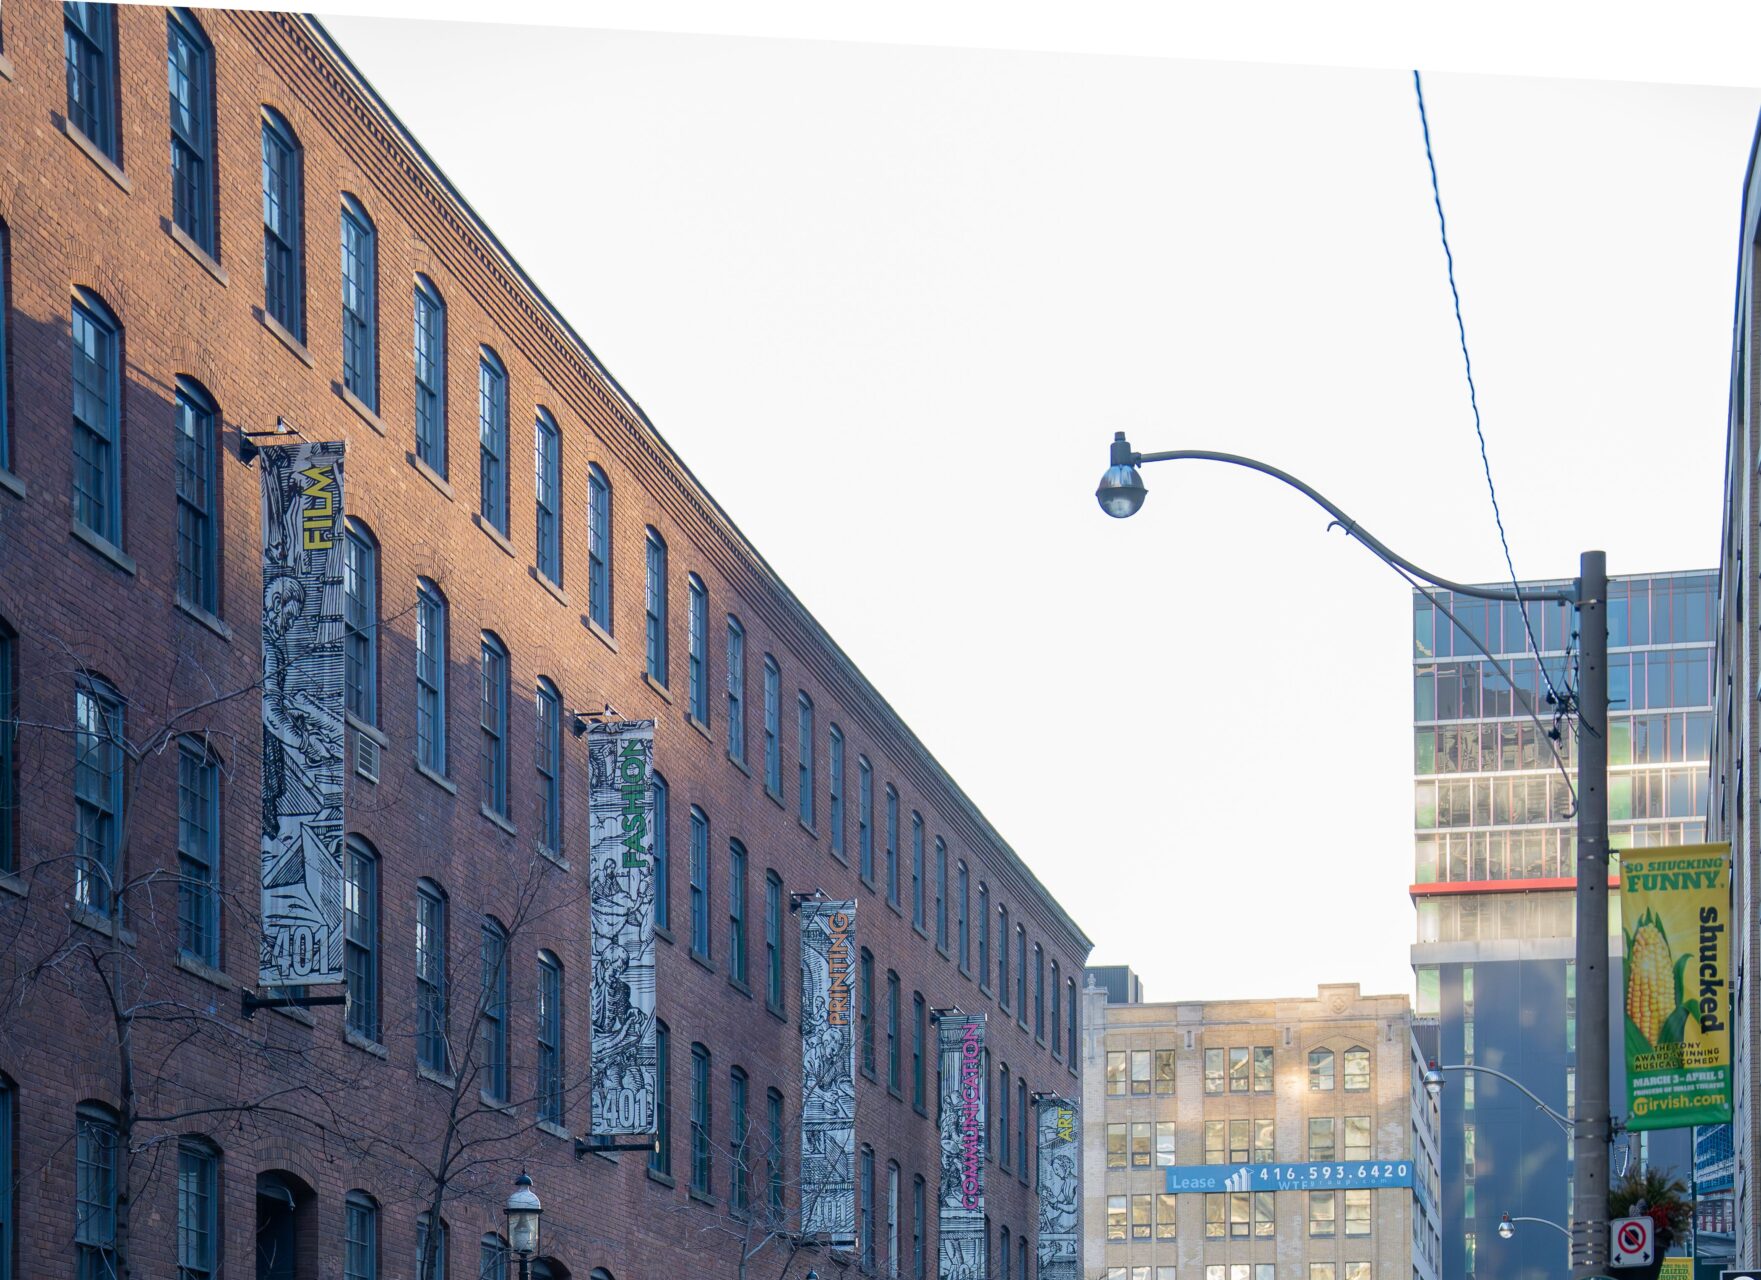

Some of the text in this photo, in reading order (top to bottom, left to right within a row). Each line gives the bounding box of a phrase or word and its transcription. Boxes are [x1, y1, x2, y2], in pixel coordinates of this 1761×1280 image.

[302, 466, 333, 550] FILM
[620, 738, 646, 869] FASHION
[1626, 858, 1723, 873] SO SHUCKING
[1627, 870, 1724, 893] FUNNY.
[272, 925, 329, 977] 401
[828, 911, 849, 1026] PRINTING
[1699, 906, 1725, 1035] shucked
[1633, 1075, 1671, 1087] MARCH
[1635, 1056, 1720, 1070] MUSICAL COMEDY
[602, 1088, 648, 1128] 401
[962, 1023, 980, 1209] COMMUNICATION
[1057, 1106, 1073, 1142] ART
[1172, 1164, 1407, 1189] Lease 416.593.6420
[810, 1196, 846, 1227] 401
